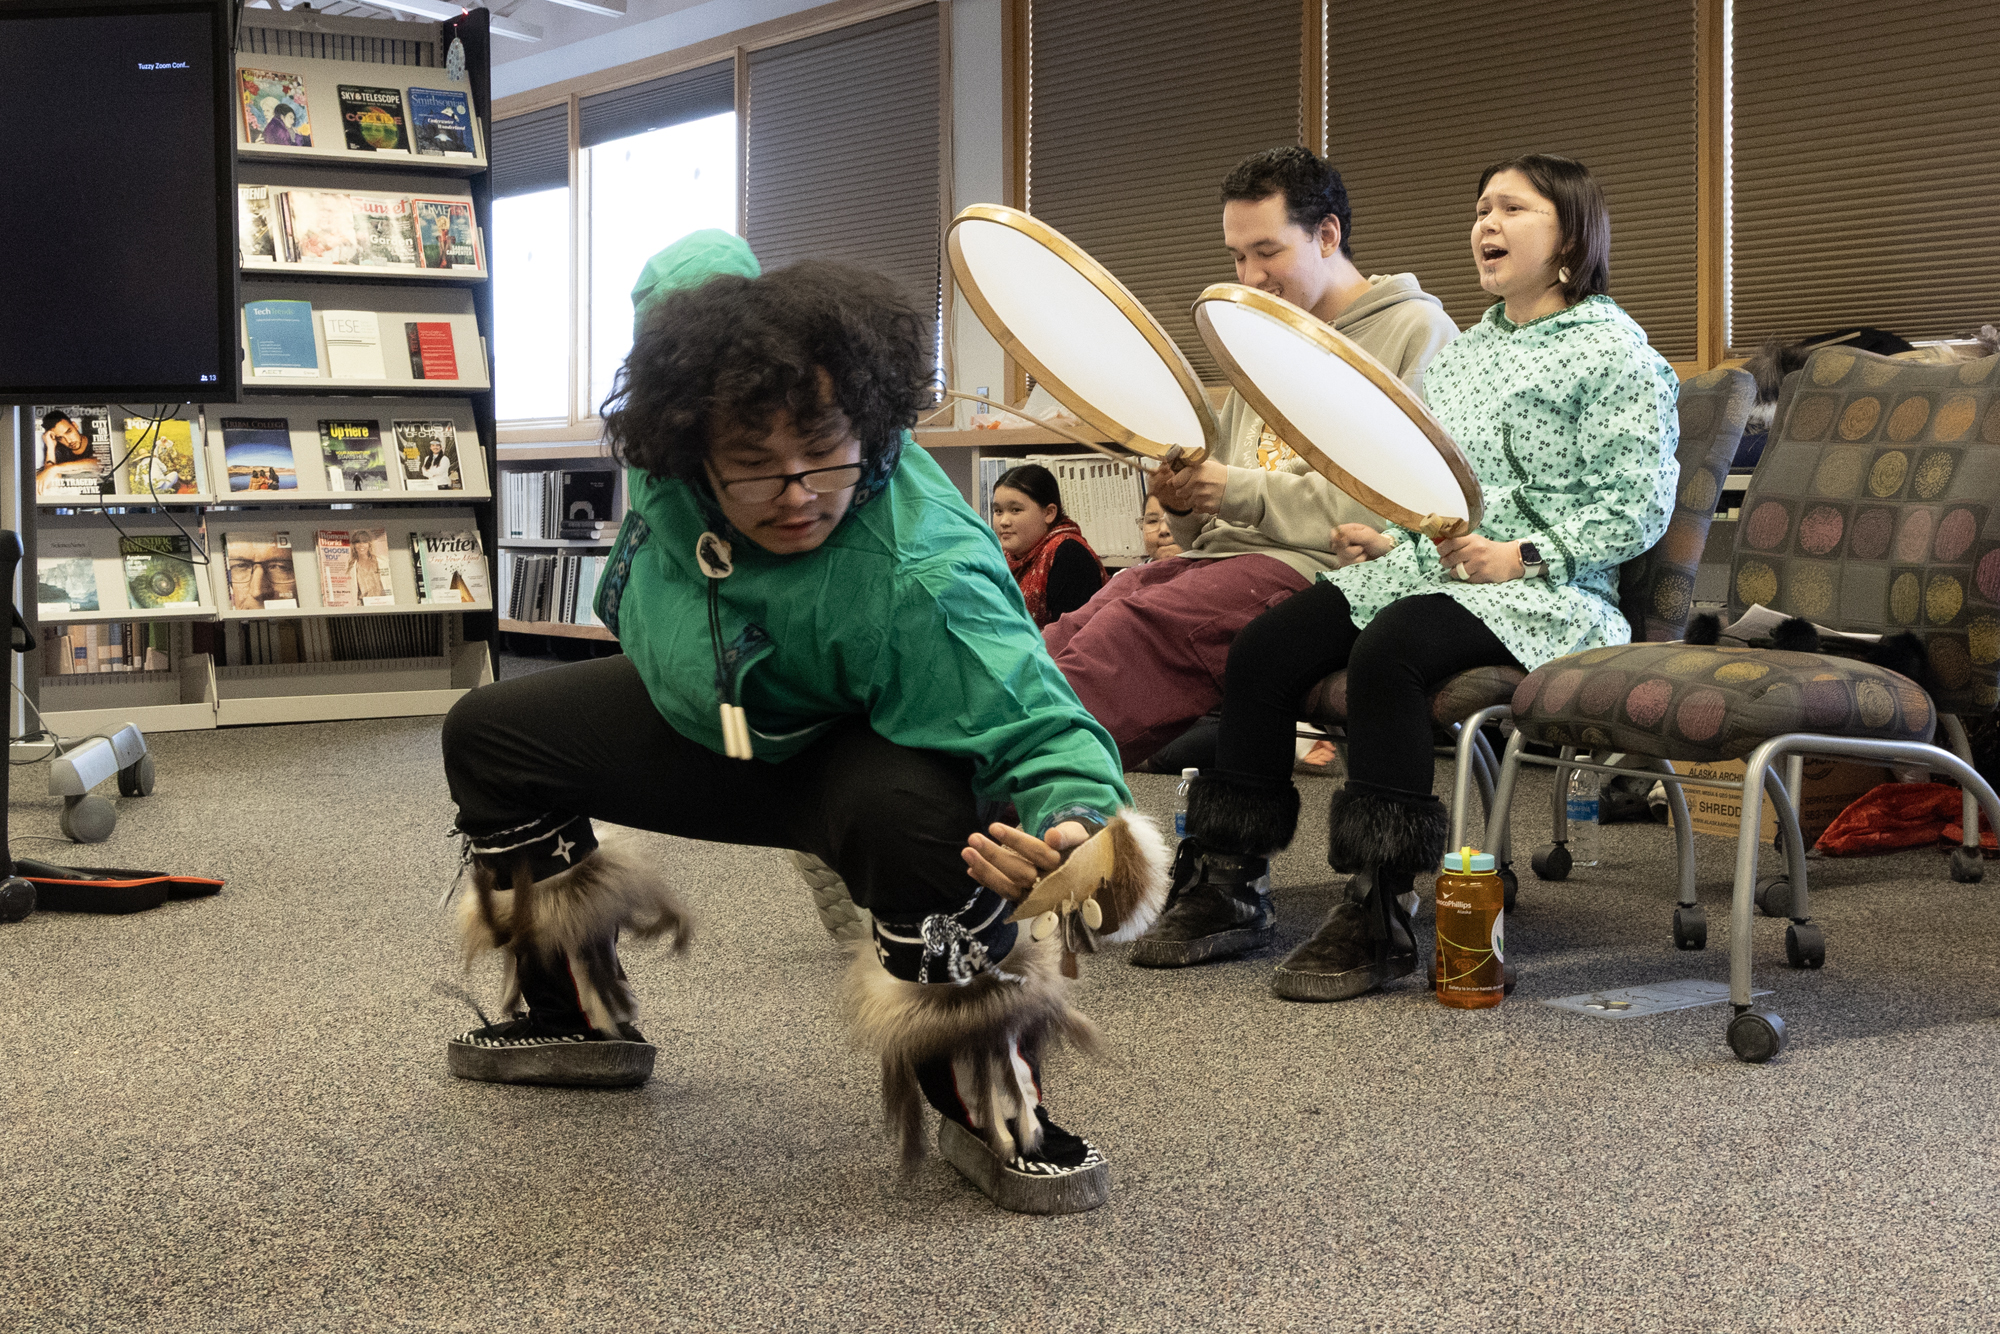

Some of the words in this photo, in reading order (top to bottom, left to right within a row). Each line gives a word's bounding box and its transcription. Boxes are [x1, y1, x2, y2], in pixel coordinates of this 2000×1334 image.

[341, 91, 354, 100] SKY
[362, 92, 400, 104] TELESCOPE
[412, 94, 467, 108] Smithsonian
[422, 204, 449, 214] TIME
[328, 320, 361, 333] TESE
[426, 537, 476, 553] Writer
[1689, 768, 1717, 780] ALASKA
